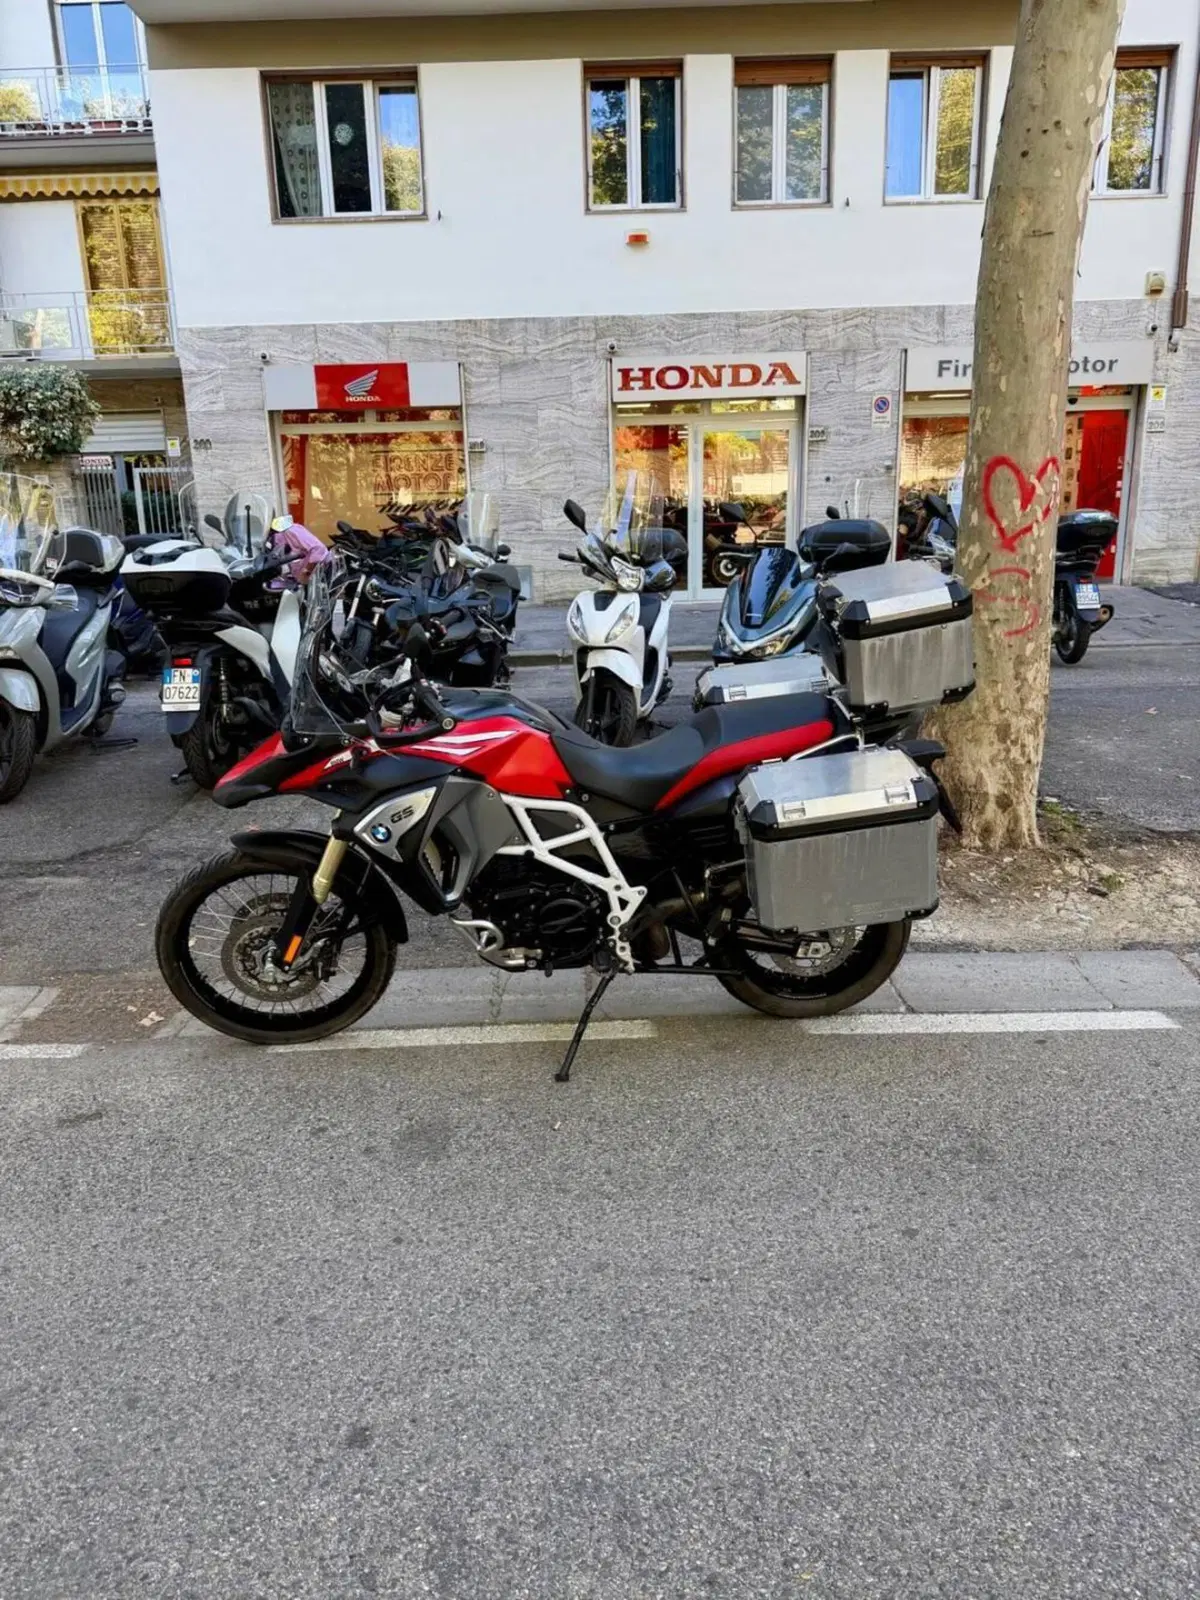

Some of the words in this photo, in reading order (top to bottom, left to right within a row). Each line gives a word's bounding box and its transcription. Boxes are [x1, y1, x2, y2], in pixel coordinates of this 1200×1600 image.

[1069, 356, 1118, 373] otor
[617, 362, 801, 391] HONDA
[372, 453, 455, 472] FIRENZE
[173, 669, 187, 682] FN
[164, 685, 198, 700] 07622
[390, 805, 415, 824] GS
